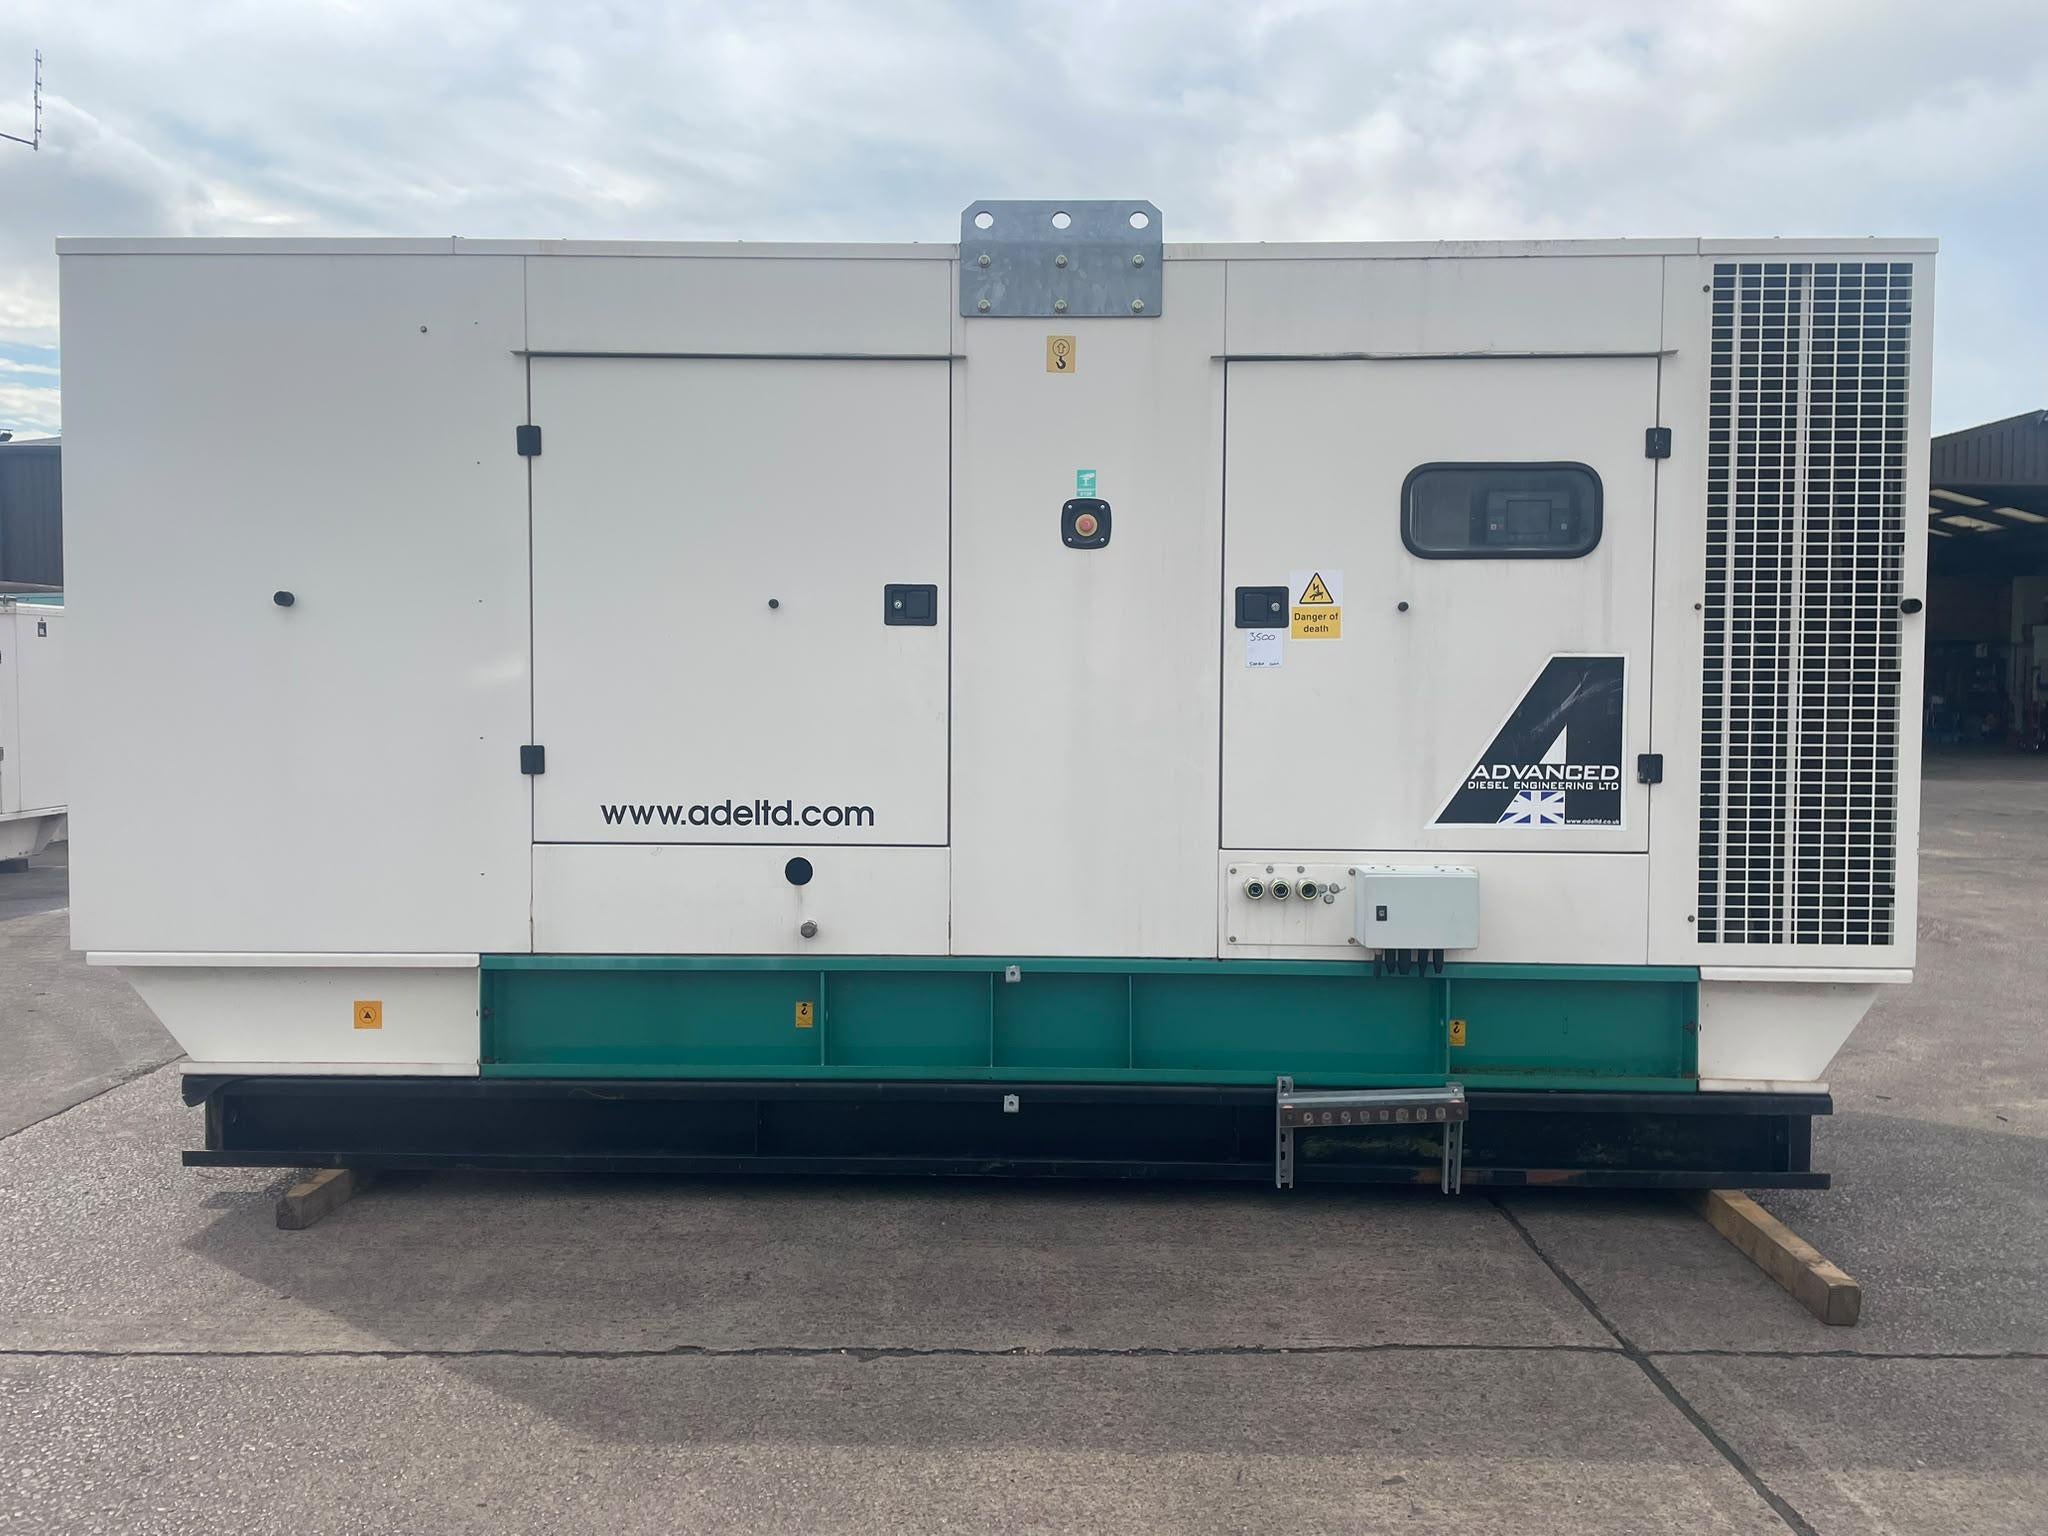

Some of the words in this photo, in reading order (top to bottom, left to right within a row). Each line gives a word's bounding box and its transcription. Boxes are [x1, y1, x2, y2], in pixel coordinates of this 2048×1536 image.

[1294, 612, 1327, 622] Danger
[1329, 612, 1338, 621] of
[1303, 625, 1329, 633] death
[1249, 632, 1276, 641] 3500
[1470, 764, 1620, 781] ADVANCED
[1467, 781, 1509, 790] DIESEL
[1513, 781, 1594, 790] ENGINEERING
[1598, 782, 1619, 791] LTD
[600, 799, 875, 827] www.adeltd.com
